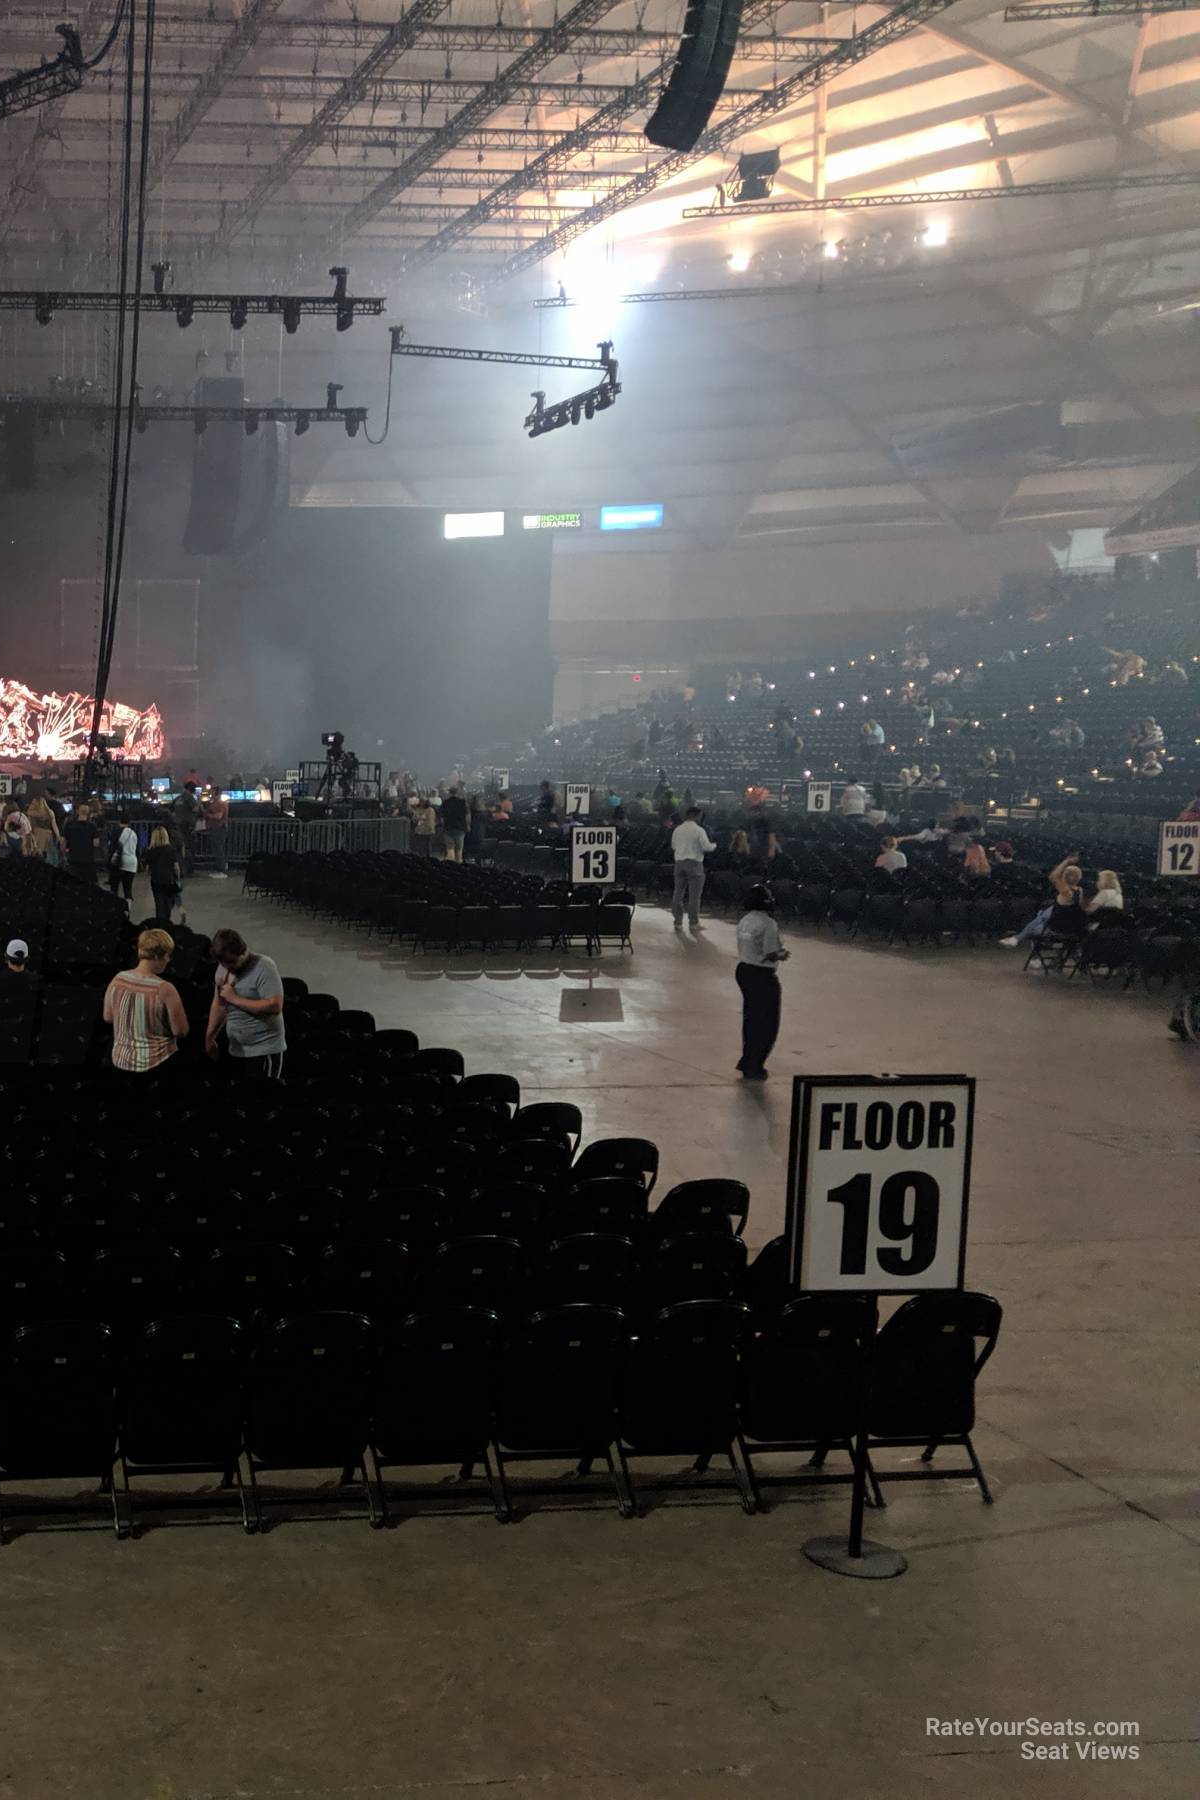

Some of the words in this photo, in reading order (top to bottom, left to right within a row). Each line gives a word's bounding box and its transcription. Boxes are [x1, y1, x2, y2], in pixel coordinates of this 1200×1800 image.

[541, 513, 580, 521] INDUSTRY
[541, 520, 580, 528] GRAPHICS
[0, 782, 7, 793] 3
[568, 786, 588, 794] FLOOR
[574, 797, 582, 812] 7
[815, 794, 825, 809] 6
[576, 831, 613, 845] FLOOR
[1166, 825, 1199, 838] FLOOR
[1168, 843, 1194, 871] 12
[579, 850, 609, 879] 13
[818, 1101, 956, 1151] FLOOR
[826, 1171, 940, 1276] 19
